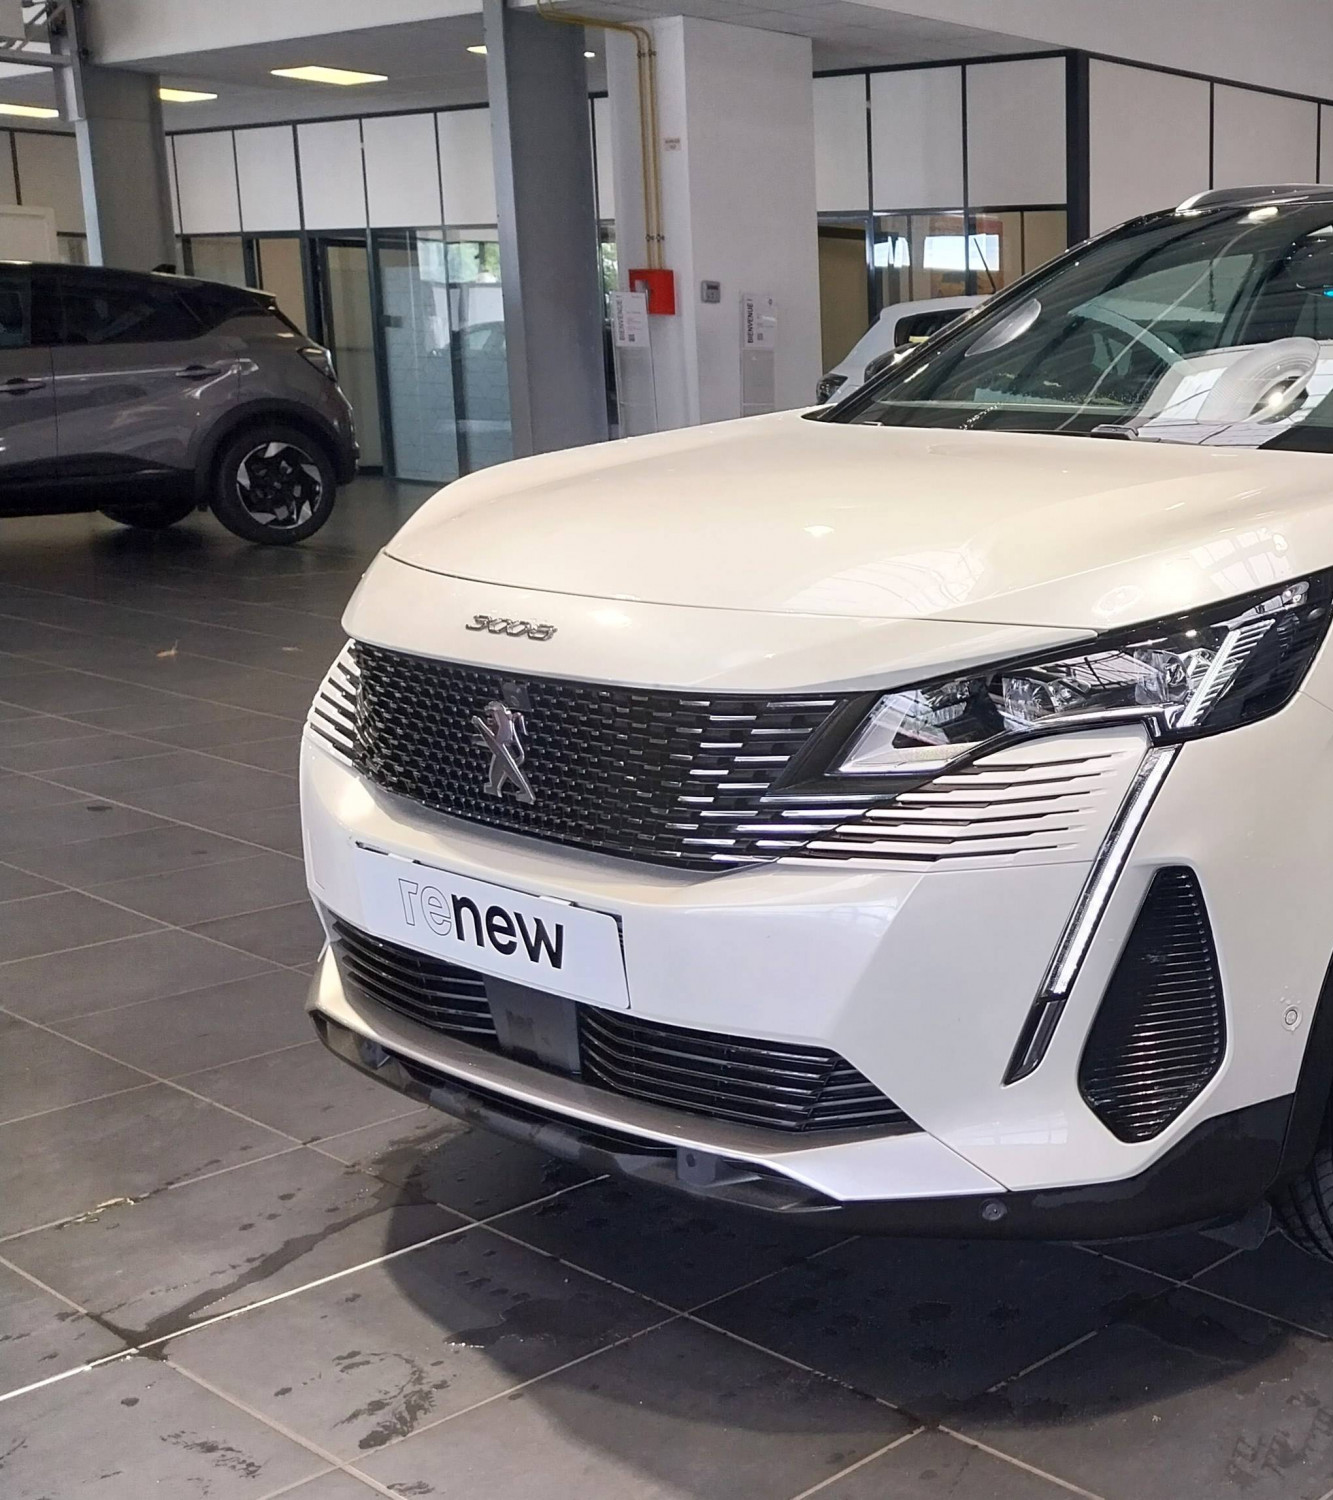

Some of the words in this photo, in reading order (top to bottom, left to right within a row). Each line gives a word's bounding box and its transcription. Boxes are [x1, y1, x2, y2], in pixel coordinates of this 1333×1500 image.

[746, 302, 754, 344] BIENVENUE
[465, 614, 558, 641] 3008
[398, 878, 564, 970] renew
